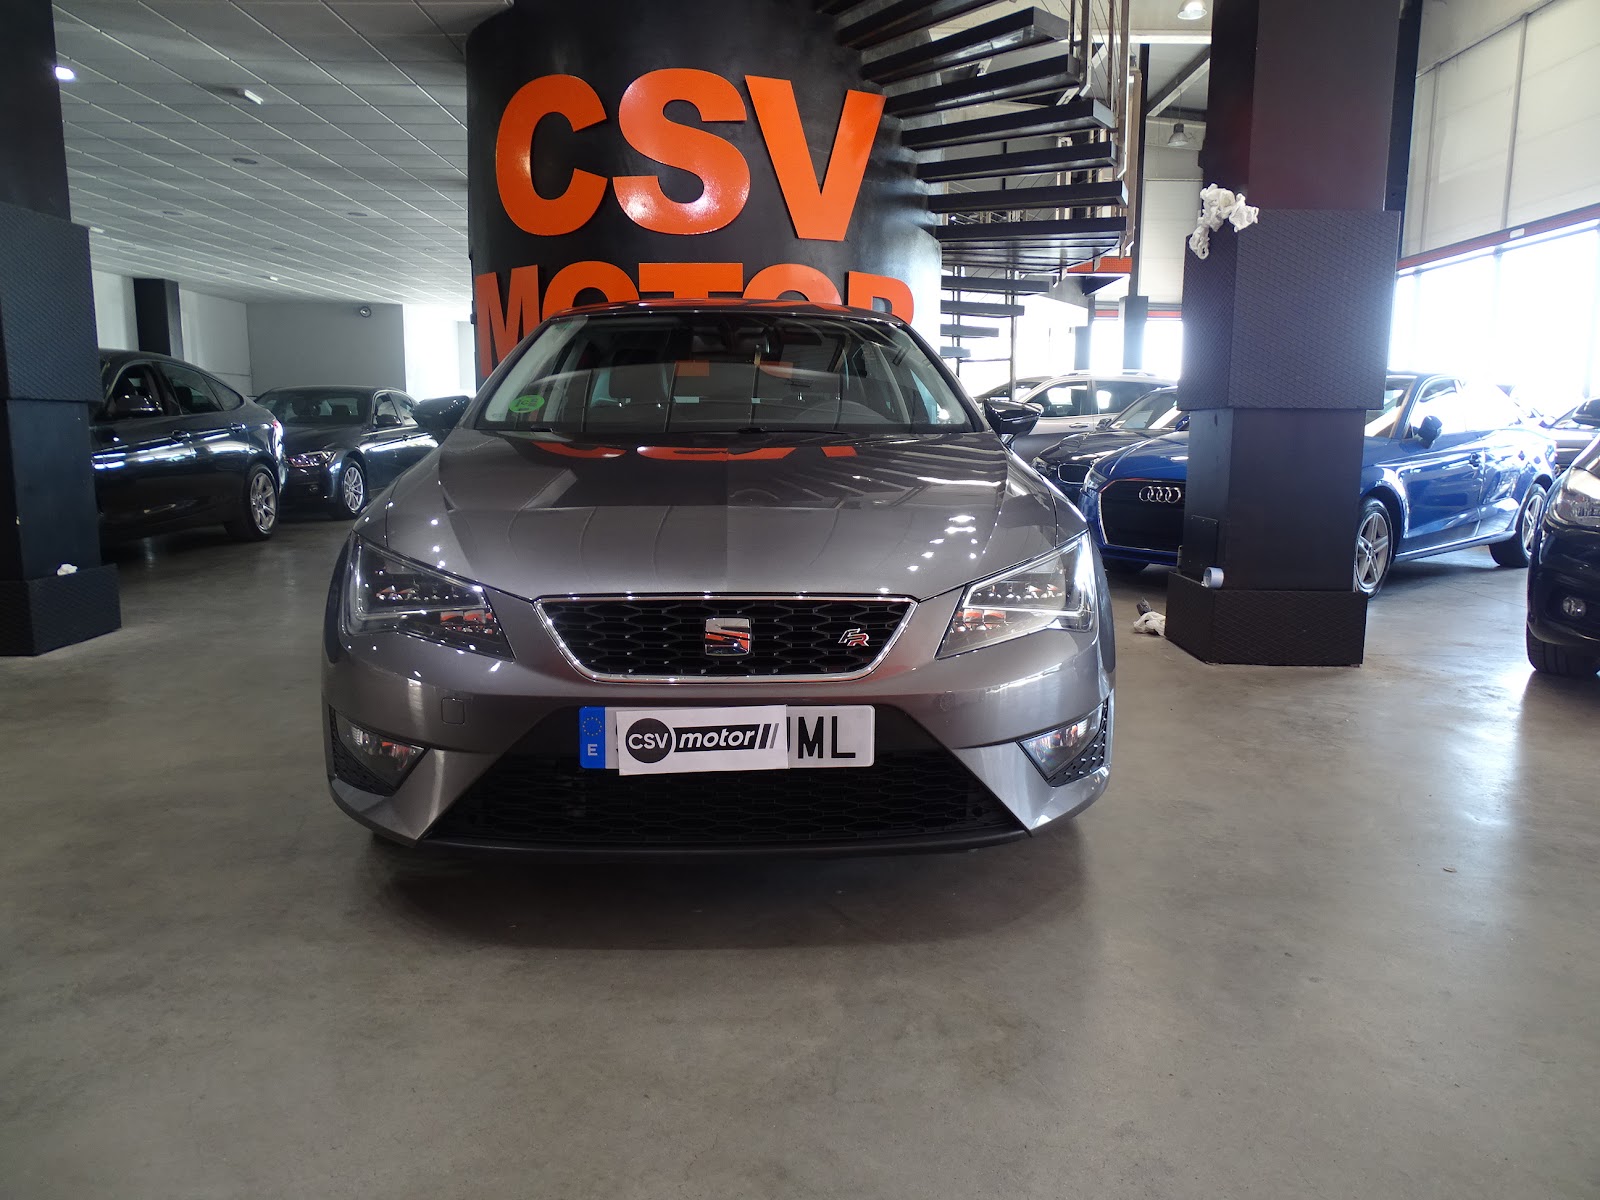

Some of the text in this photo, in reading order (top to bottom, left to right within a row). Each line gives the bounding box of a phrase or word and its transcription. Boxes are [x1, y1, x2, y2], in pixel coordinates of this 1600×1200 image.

[496, 68, 886, 241] CSV
[587, 743, 598, 756] E
[628, 733, 669, 750] CSV
[679, 729, 755, 748] motor
[787, 716, 856, 759] ML
